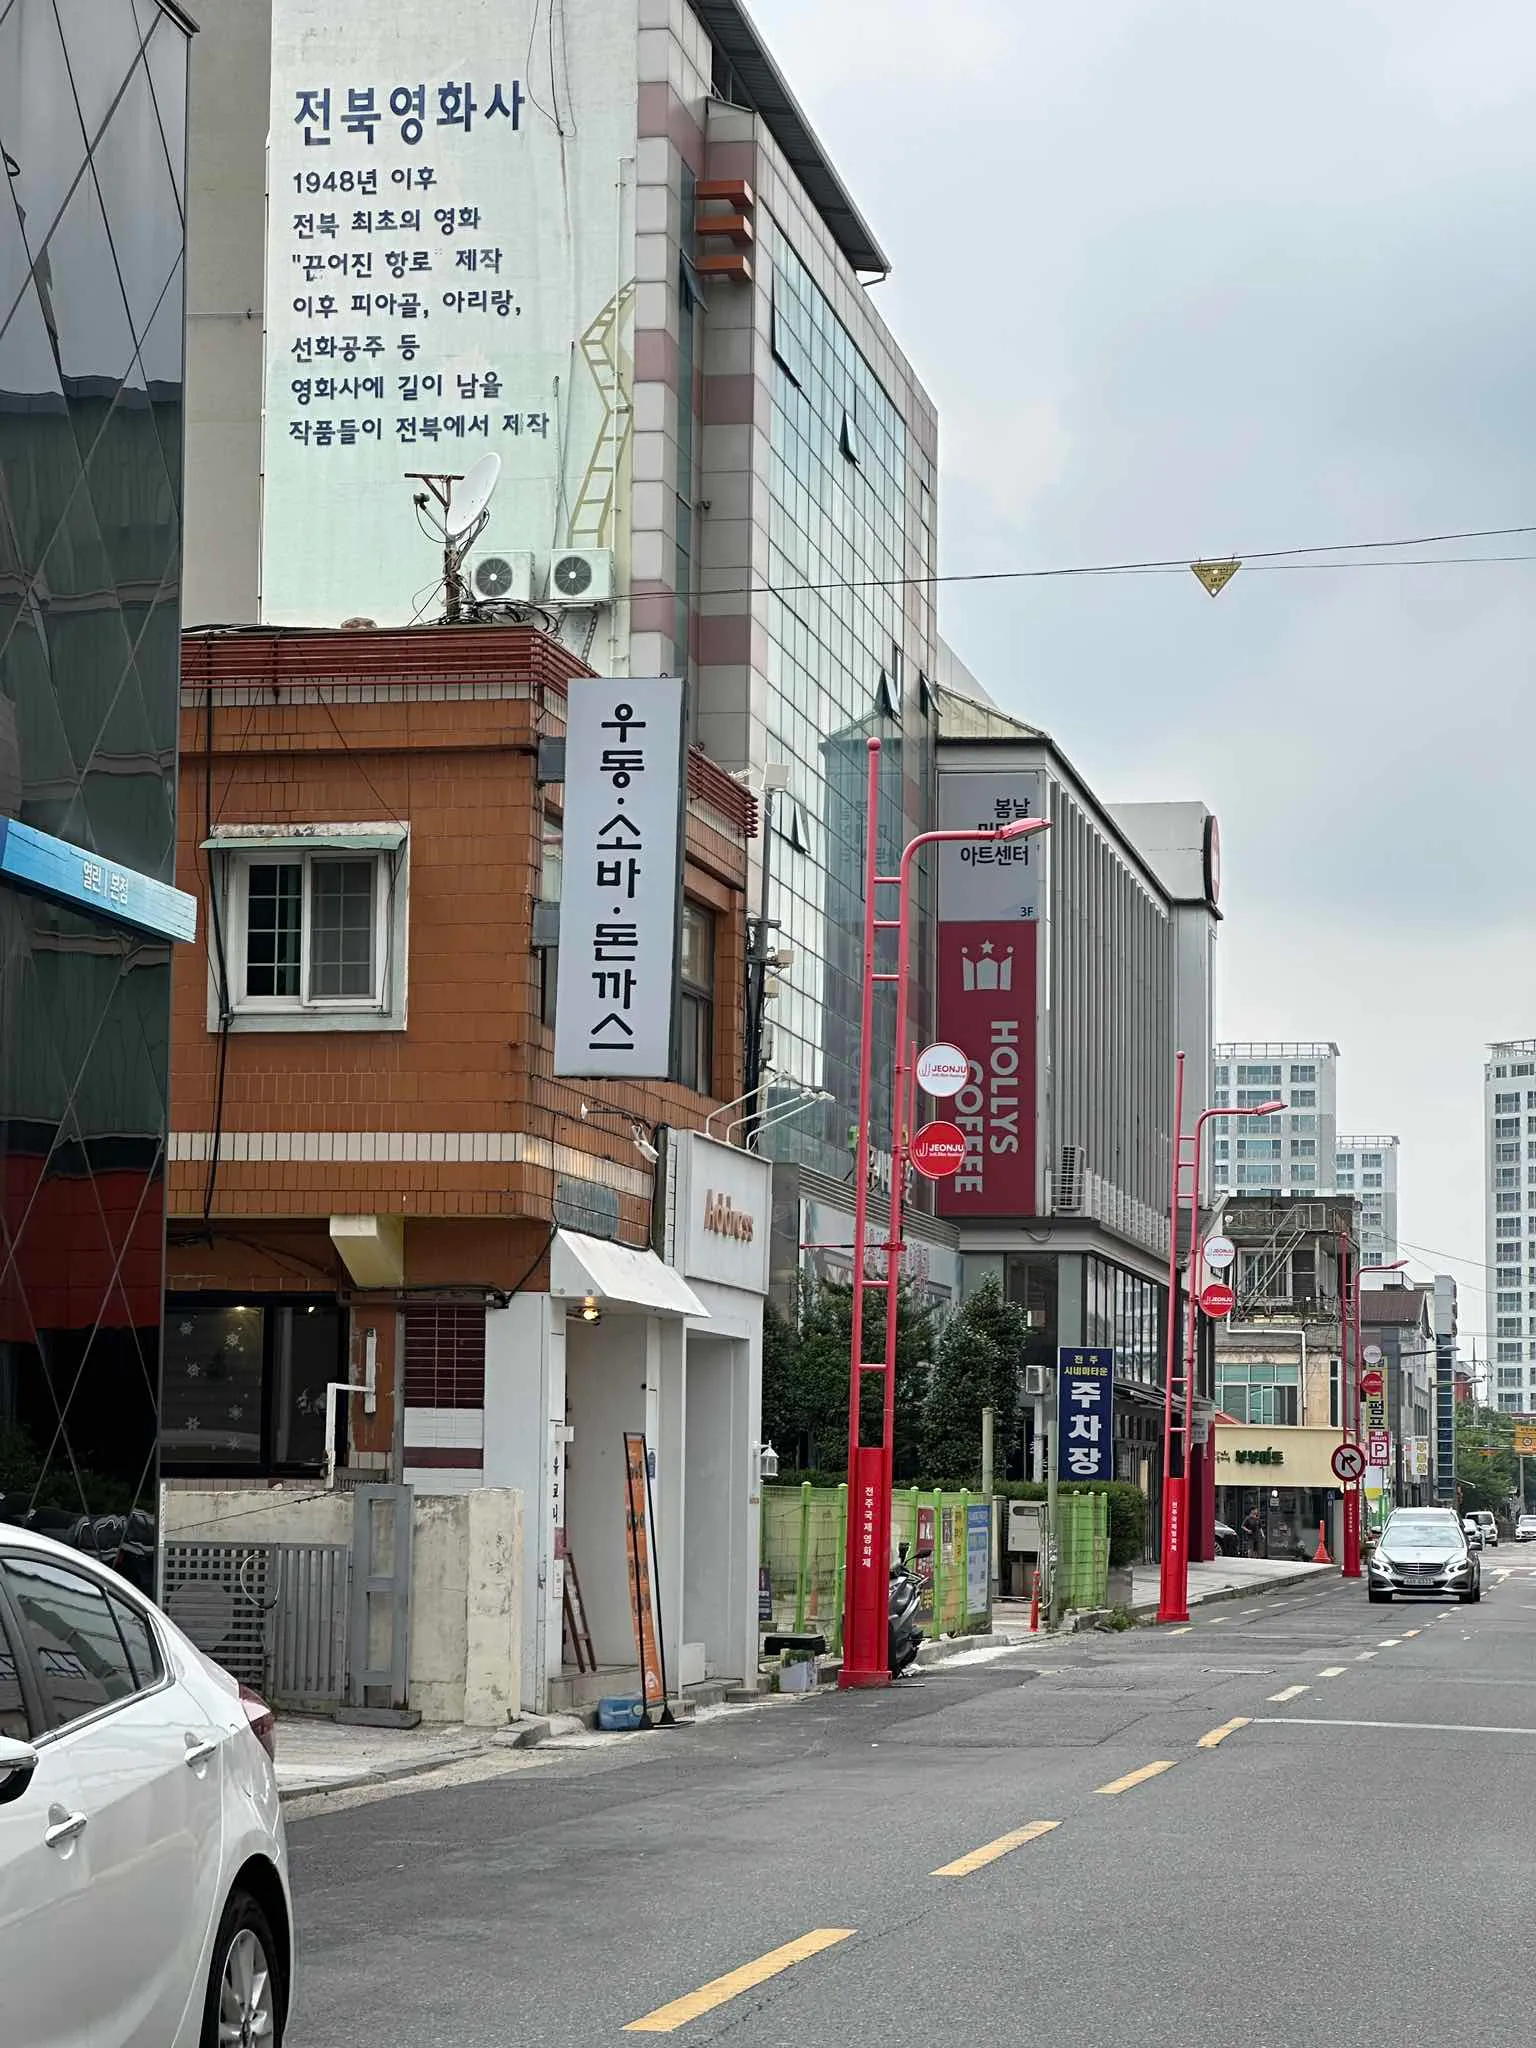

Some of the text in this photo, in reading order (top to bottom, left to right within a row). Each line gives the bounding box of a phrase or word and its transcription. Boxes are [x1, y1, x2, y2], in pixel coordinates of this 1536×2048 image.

[294, 80, 525, 146] 전북영화사
[293, 166, 438, 195] 1948년 이후
[293, 206, 481, 239] 전북 최초의 영화
[455, 247, 503, 274] 제작
[293, 289, 522, 319] 이후 피아골, 아리랑,
[291, 333, 420, 363] 선화공주 등
[291, 371, 503, 405] 영화사에 길이 남을
[289, 411, 550, 446] 작품들이 전북에서 제작
[993, 797, 1031, 819] 봄날
[960, 844, 1028, 867] 아트센터
[1019, 906, 1034, 917] 3F
[931, 1065, 966, 1073] JEONJU
[990, 1020, 1019, 1154] HOLLYS
[929, 1143, 964, 1152] JEONJU
[1064, 1365, 1108, 1376] 시네마타운
[1067, 1381, 1102, 1475] 주차장
[1375, 1443, 1385, 1456] P
[862, 1486, 874, 1569] 전주국제영화제
